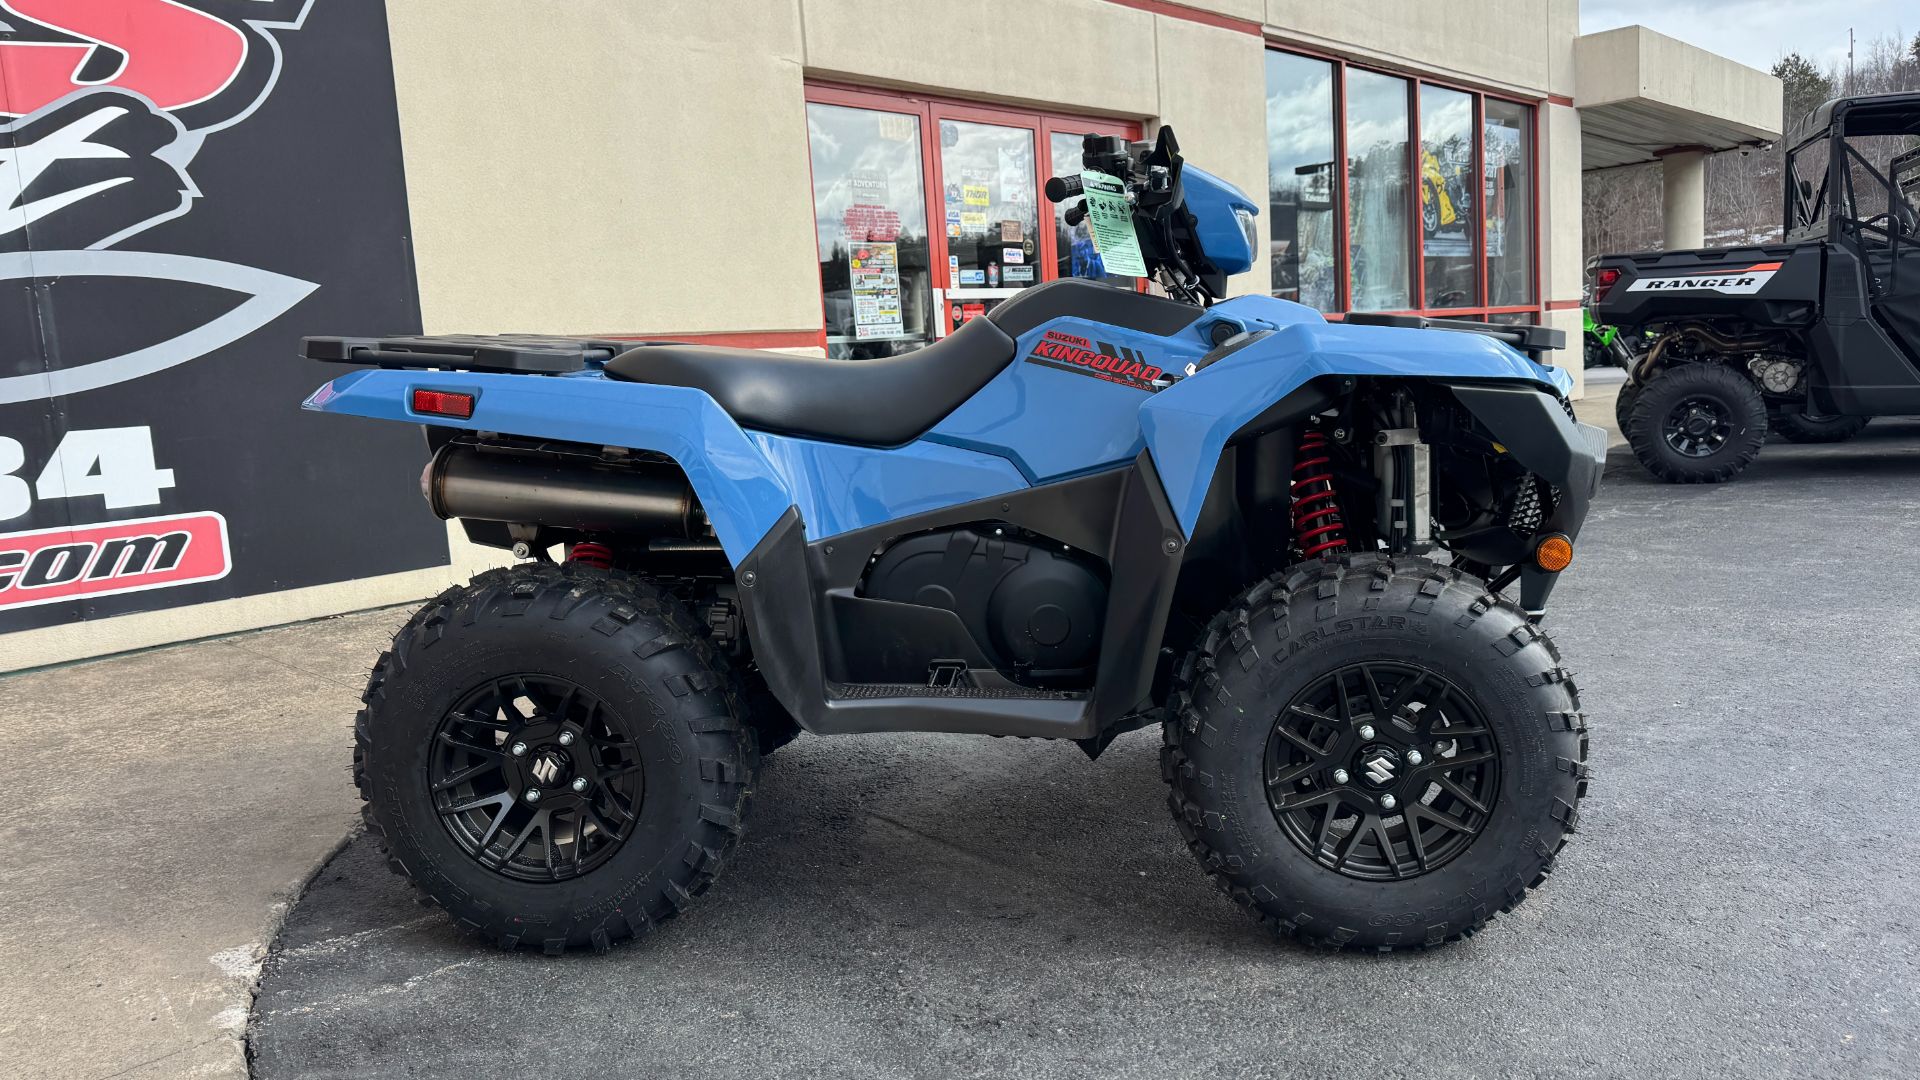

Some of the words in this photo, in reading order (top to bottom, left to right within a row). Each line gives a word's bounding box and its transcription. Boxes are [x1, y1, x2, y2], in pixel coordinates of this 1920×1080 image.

[1096, 182, 1117, 192] WARNING
[965, 189, 987, 199] THOR
[1646, 277, 1756, 289] RANGER
[1047, 331, 1088, 346] SUZUKI
[1032, 340, 1164, 381] KINGQUAD
[1272, 615, 1406, 664] CARLSTAR
